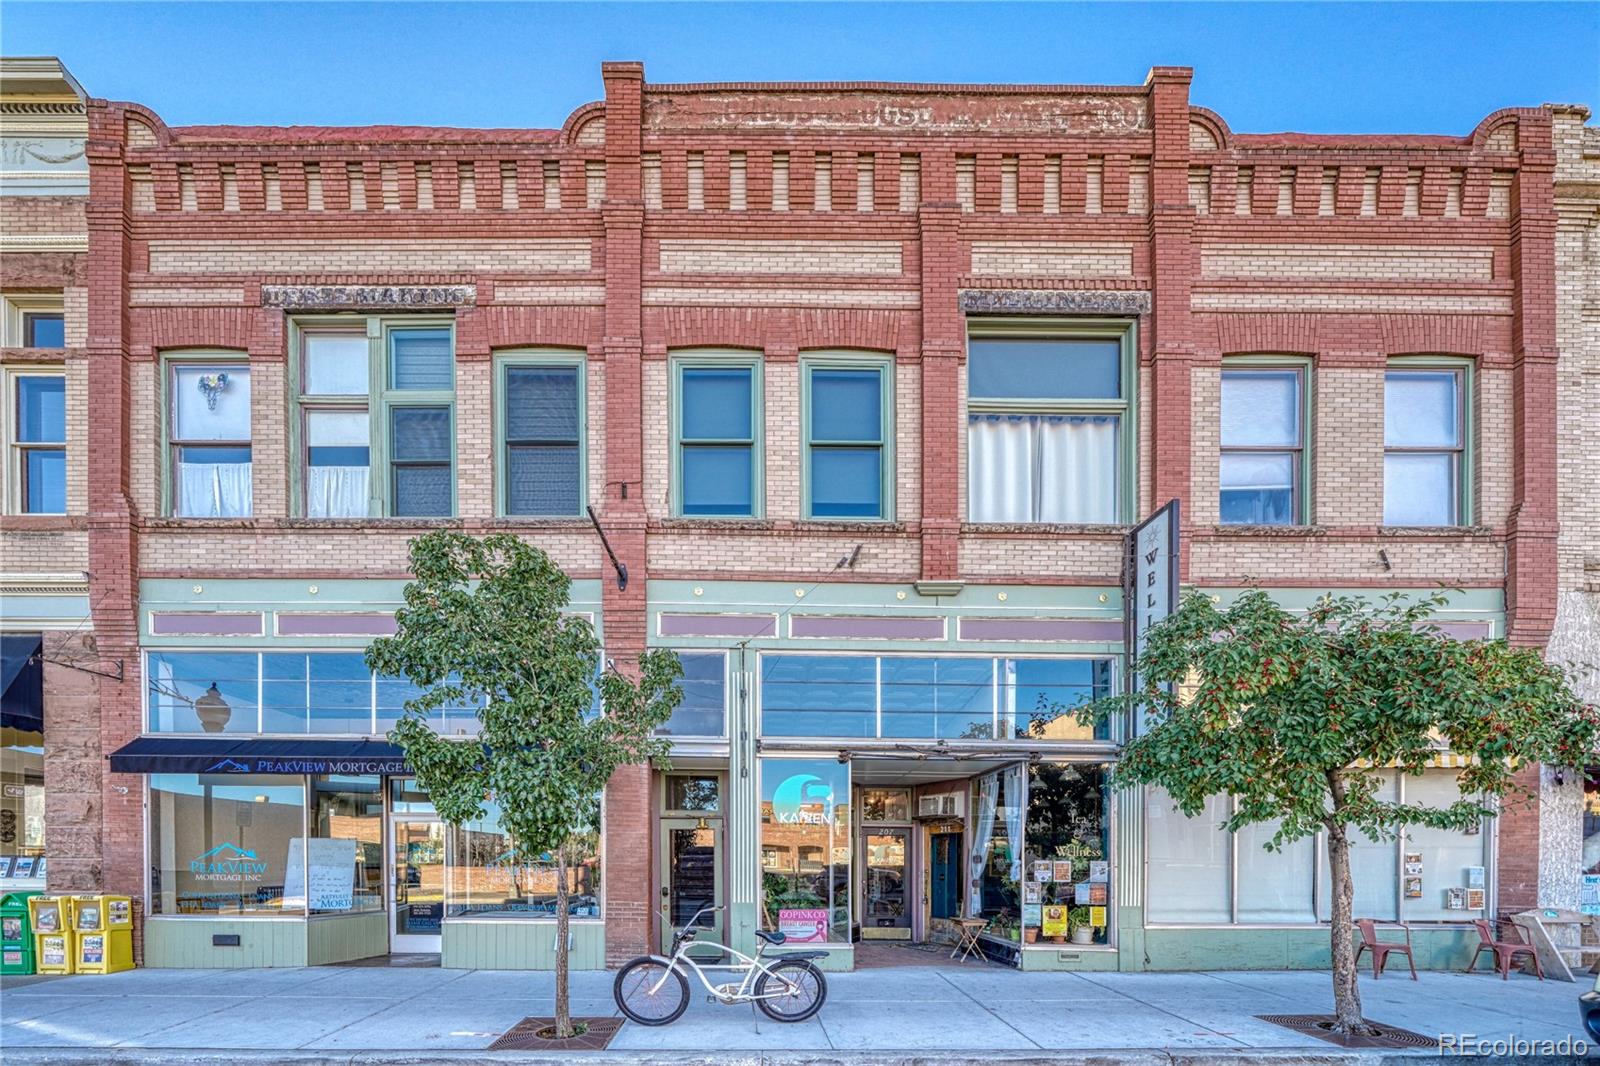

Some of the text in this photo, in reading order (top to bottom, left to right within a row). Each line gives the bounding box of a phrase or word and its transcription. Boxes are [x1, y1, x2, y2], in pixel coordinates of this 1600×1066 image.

[257, 760, 326, 773] PEAKVIEW
[329, 761, 403, 773] MORTGAGE
[1055, 845, 1102, 857] Wellness
[194, 873, 242, 881] MORTGAGE
[245, 873, 262, 881] INC
